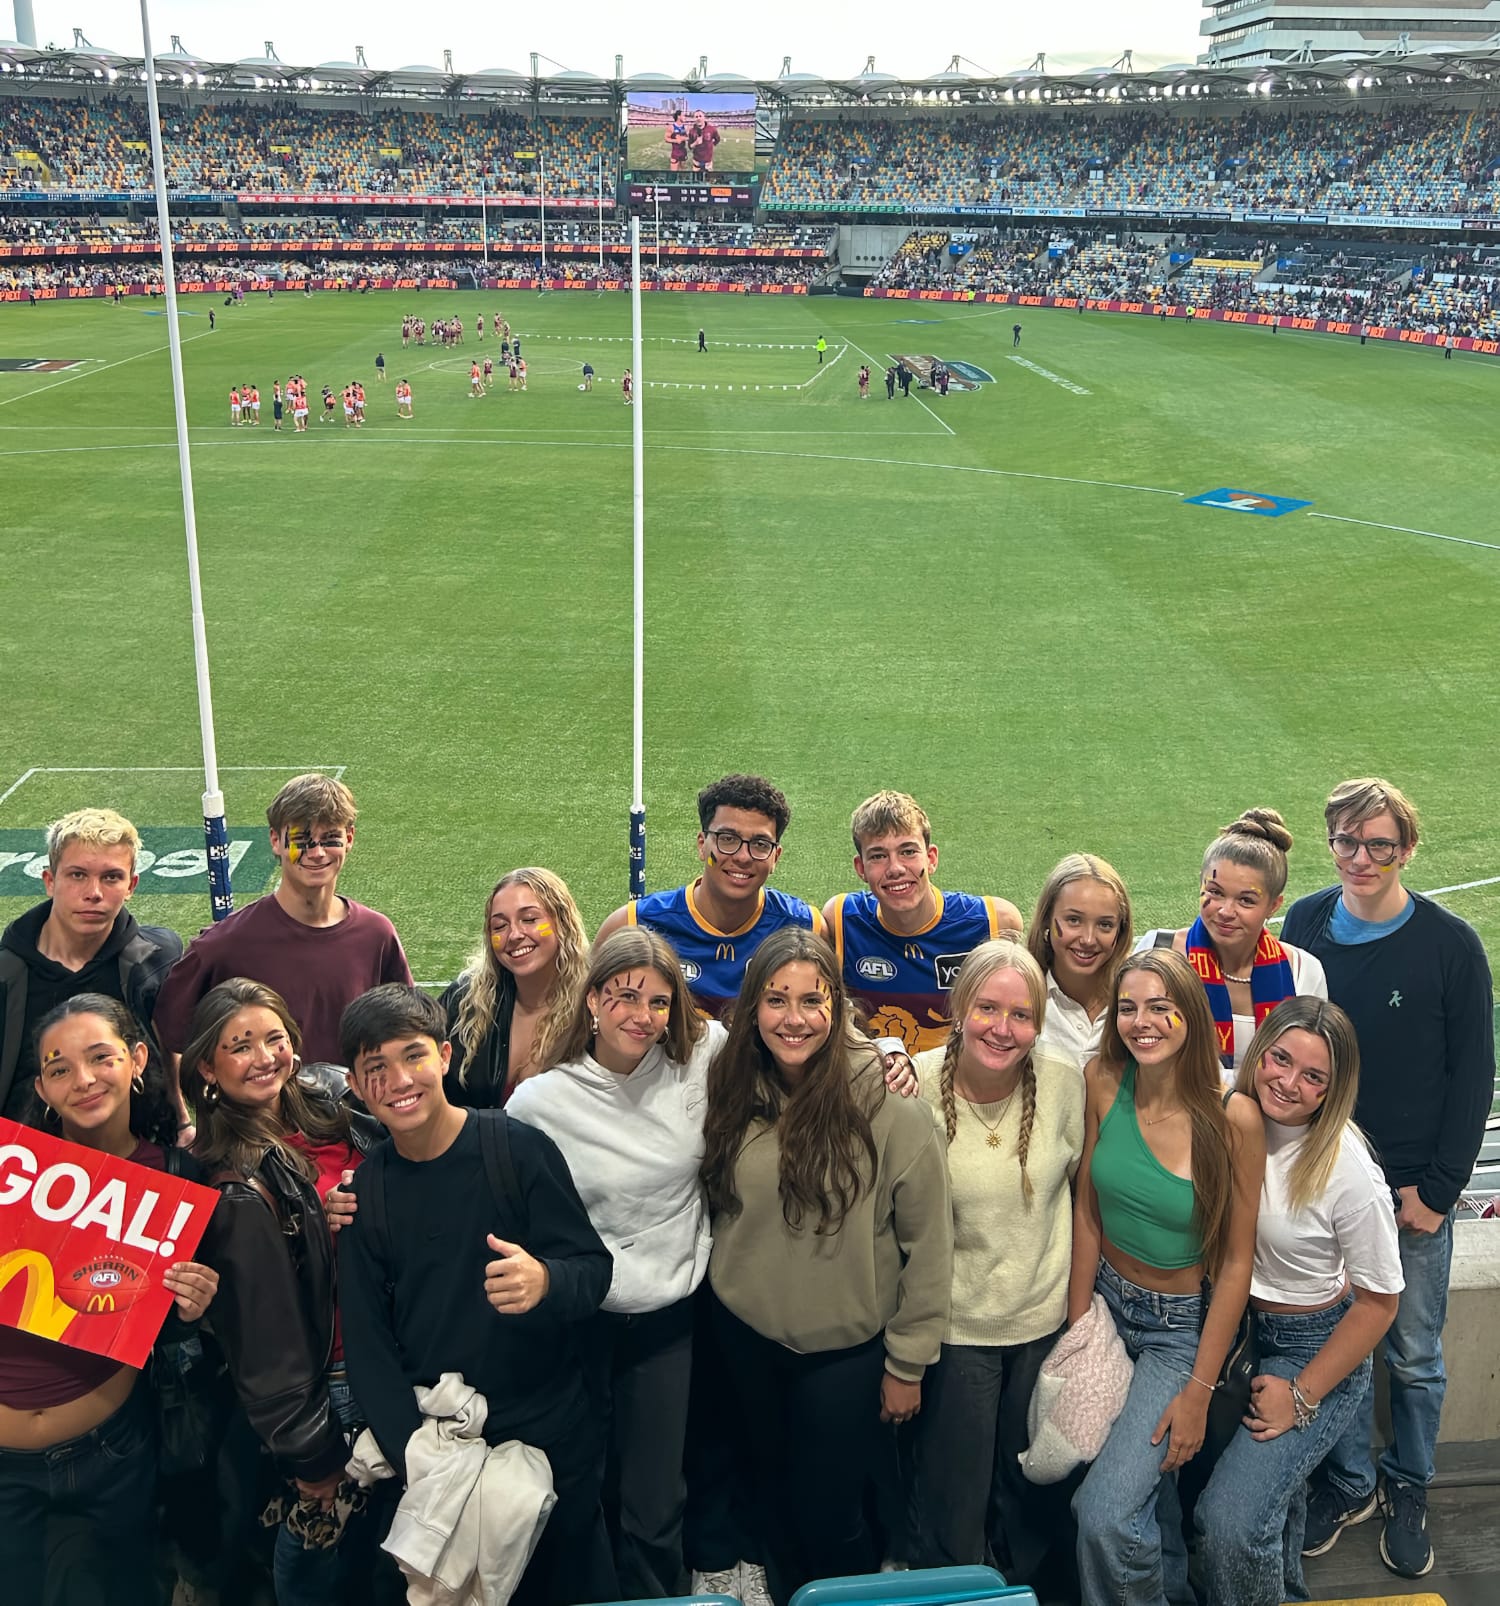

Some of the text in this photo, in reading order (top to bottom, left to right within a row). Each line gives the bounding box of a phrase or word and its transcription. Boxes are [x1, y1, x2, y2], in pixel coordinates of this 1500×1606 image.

[180, 283, 204, 292] UP NEXT
[216, 283, 224, 291] UP
[286, 281, 294, 289] UP
[427, 280, 436, 288] UP
[498, 280, 520, 288] UP NEXT
[564, 280, 572, 289] UP
[572, 280, 587, 289] NEXT
[664, 282, 687, 290] UP NEXT
[704, 282, 719, 291] NEXT
[728, 284, 737, 292] UP
[69, 288, 77, 297] UP
[761, 285, 784, 293] UP NEXT
[887, 289, 910, 298] UP NEXT
[42, 289, 57, 299] NEXT
[920, 290, 943, 299] UP NEXT
[953, 292, 961, 300] UP
[986, 294, 1009, 303] UP NEXT
[1019, 296, 1042, 305] UP NEXT
[1055, 298, 1077, 307] UP NEXT
[1087, 300, 1095, 308] UP
[1120, 302, 1143, 312] UP NEXT
[1153, 305, 1161, 314] UP
[1224, 311, 1248, 322] UP NEXT
[1258, 314, 1266, 324] UP
[1292, 317, 1316, 328] UP NEXT
[1327, 321, 1351, 334] UP NEXT
[1400, 330, 1425, 343] UP NEXT
[1436, 334, 1445, 345] UP
[1472, 339, 1482, 351] UP
[1481, 341, 1499, 353] NEXT
[680, 964, 698, 978] FL
[860, 962, 893, 976] AFL
[0, 1144, 194, 1258] GOAL!
[72, 1261, 140, 1282] SHERRIN
[94, 1272, 120, 1283] AFL
